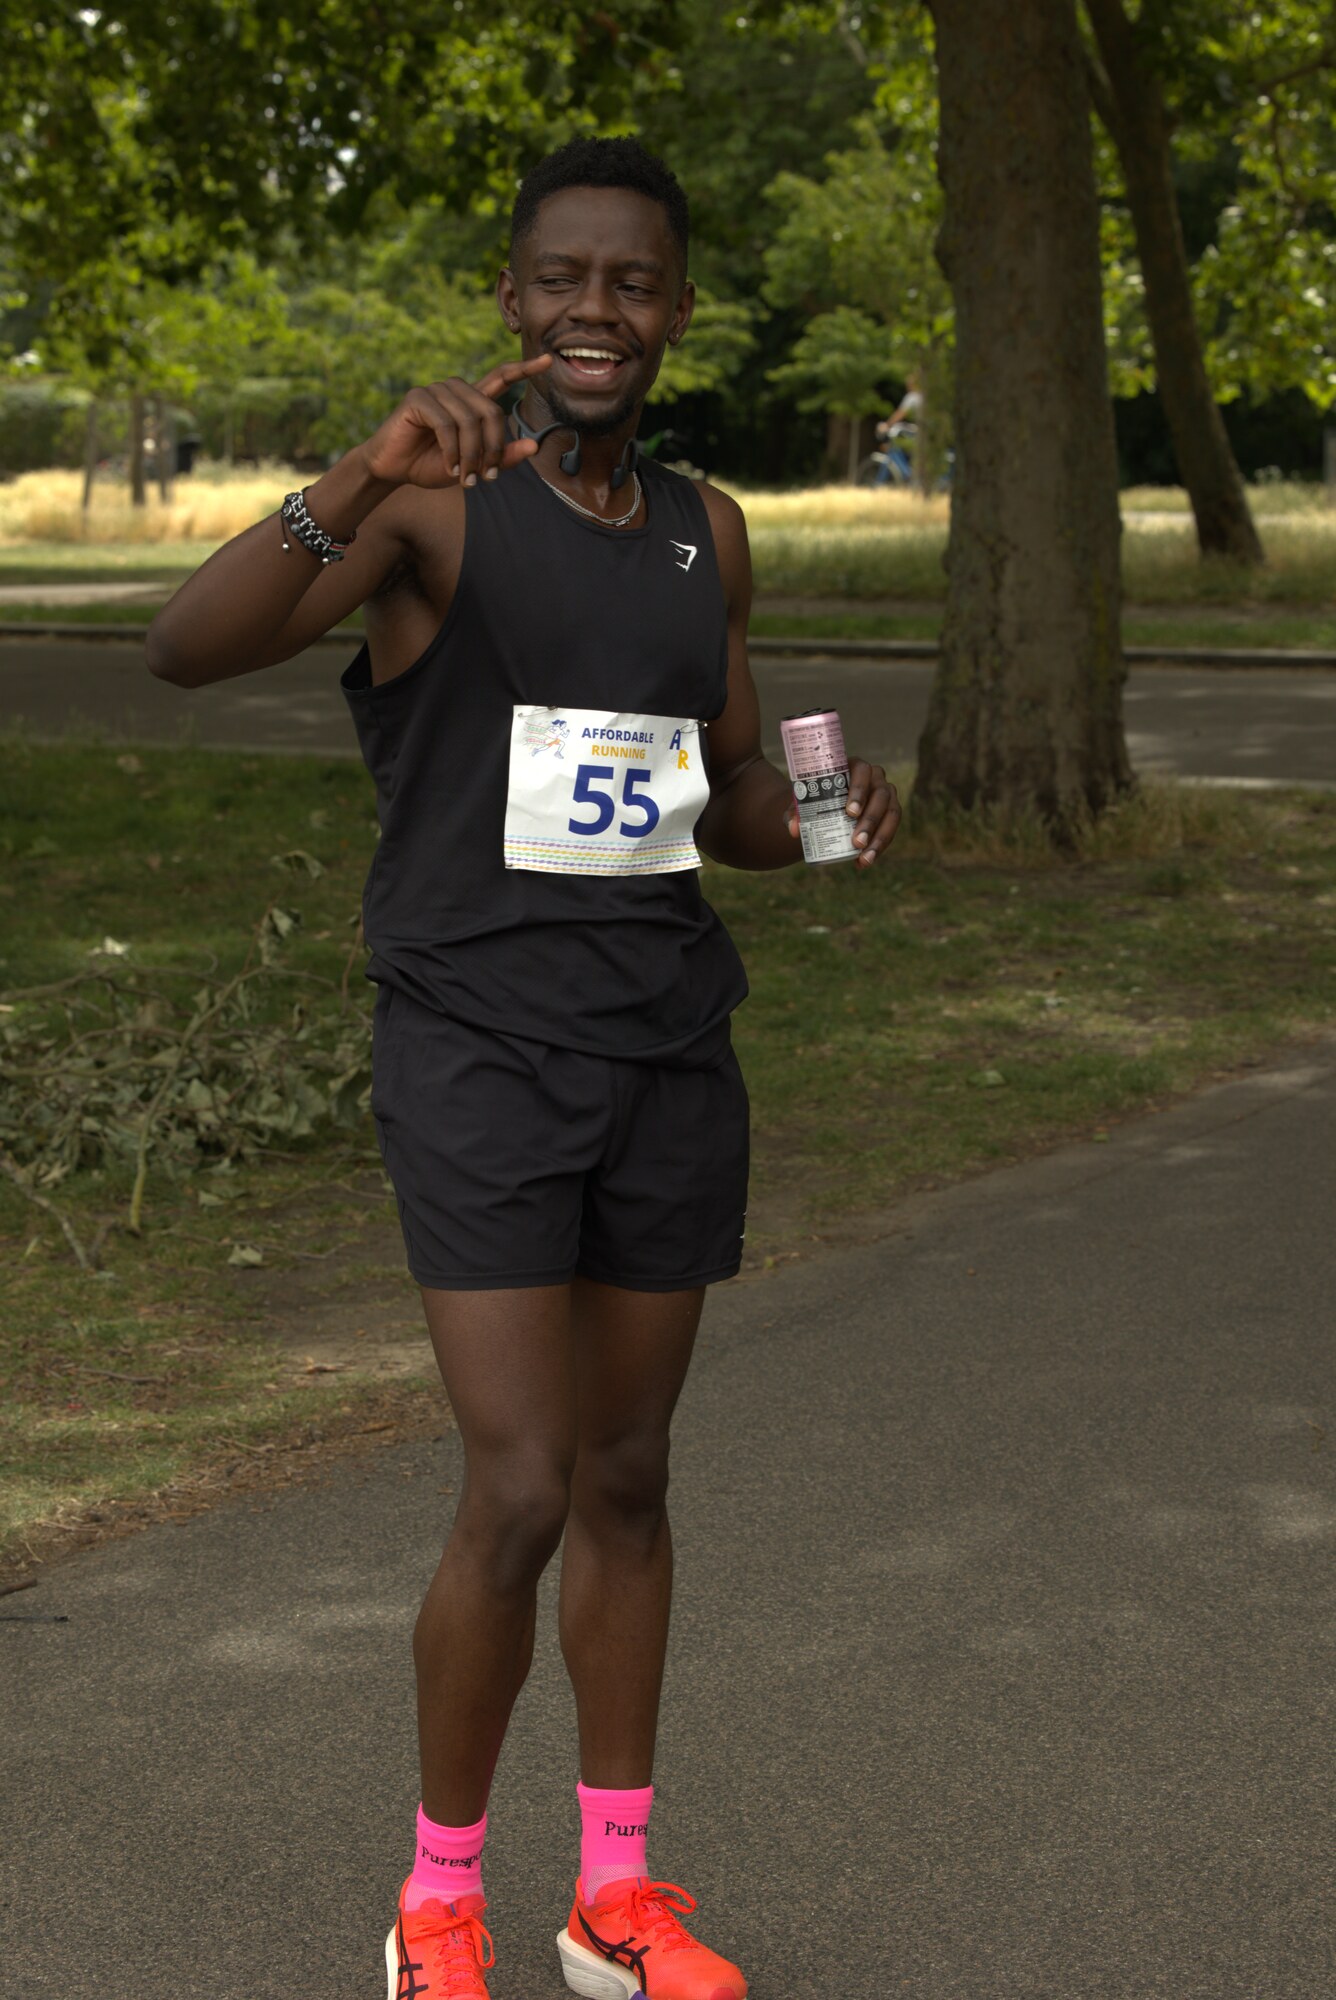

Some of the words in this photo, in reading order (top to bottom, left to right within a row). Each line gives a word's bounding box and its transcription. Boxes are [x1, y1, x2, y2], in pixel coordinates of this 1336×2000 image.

[581, 727, 654, 744] AFFORDABLE
[591, 745, 646, 760] RUNNING
[568, 764, 660, 838] 55
